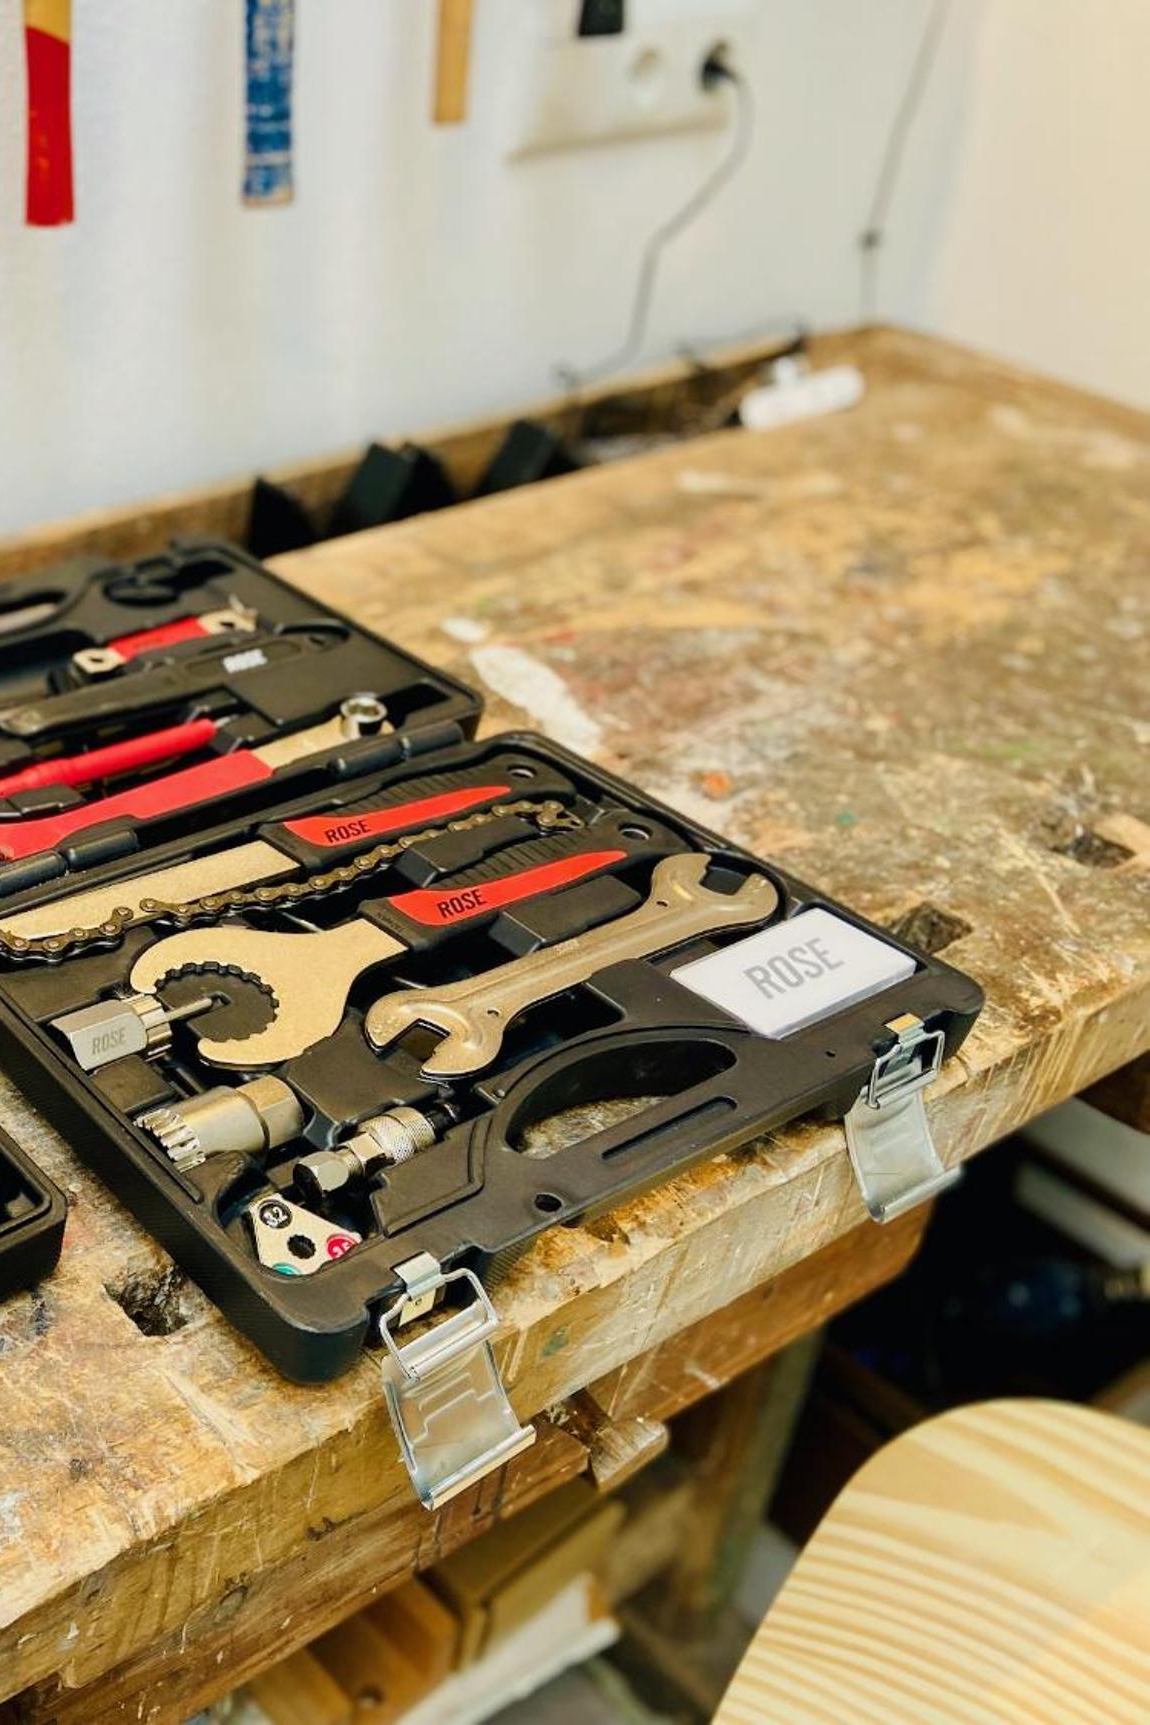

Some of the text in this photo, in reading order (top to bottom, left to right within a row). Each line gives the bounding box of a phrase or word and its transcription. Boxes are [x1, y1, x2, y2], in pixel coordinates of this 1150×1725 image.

[324, 818, 372, 843] ROSE
[437, 888, 488, 918] ROSE
[743, 937, 846, 999] ROSE
[92, 1027, 126, 1055] ROSE
